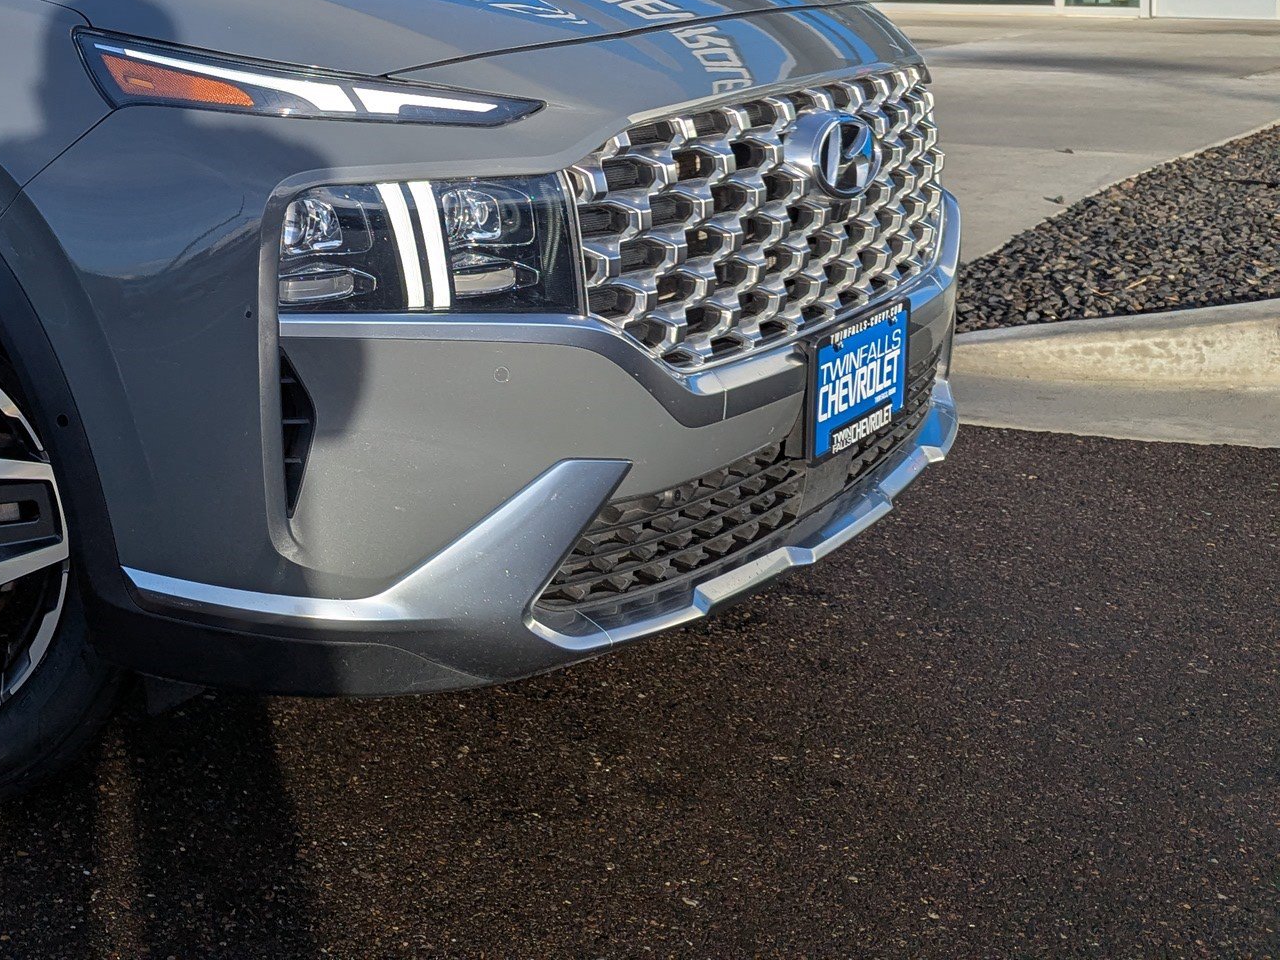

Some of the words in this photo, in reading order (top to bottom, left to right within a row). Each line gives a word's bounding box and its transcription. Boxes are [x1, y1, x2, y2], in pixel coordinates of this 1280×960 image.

[817, 348, 901, 423] CHEVROLET
[832, 426, 852, 444] TWIN
[851, 403, 893, 443] CHEVROLET
[831, 437, 852, 455] FALLS
